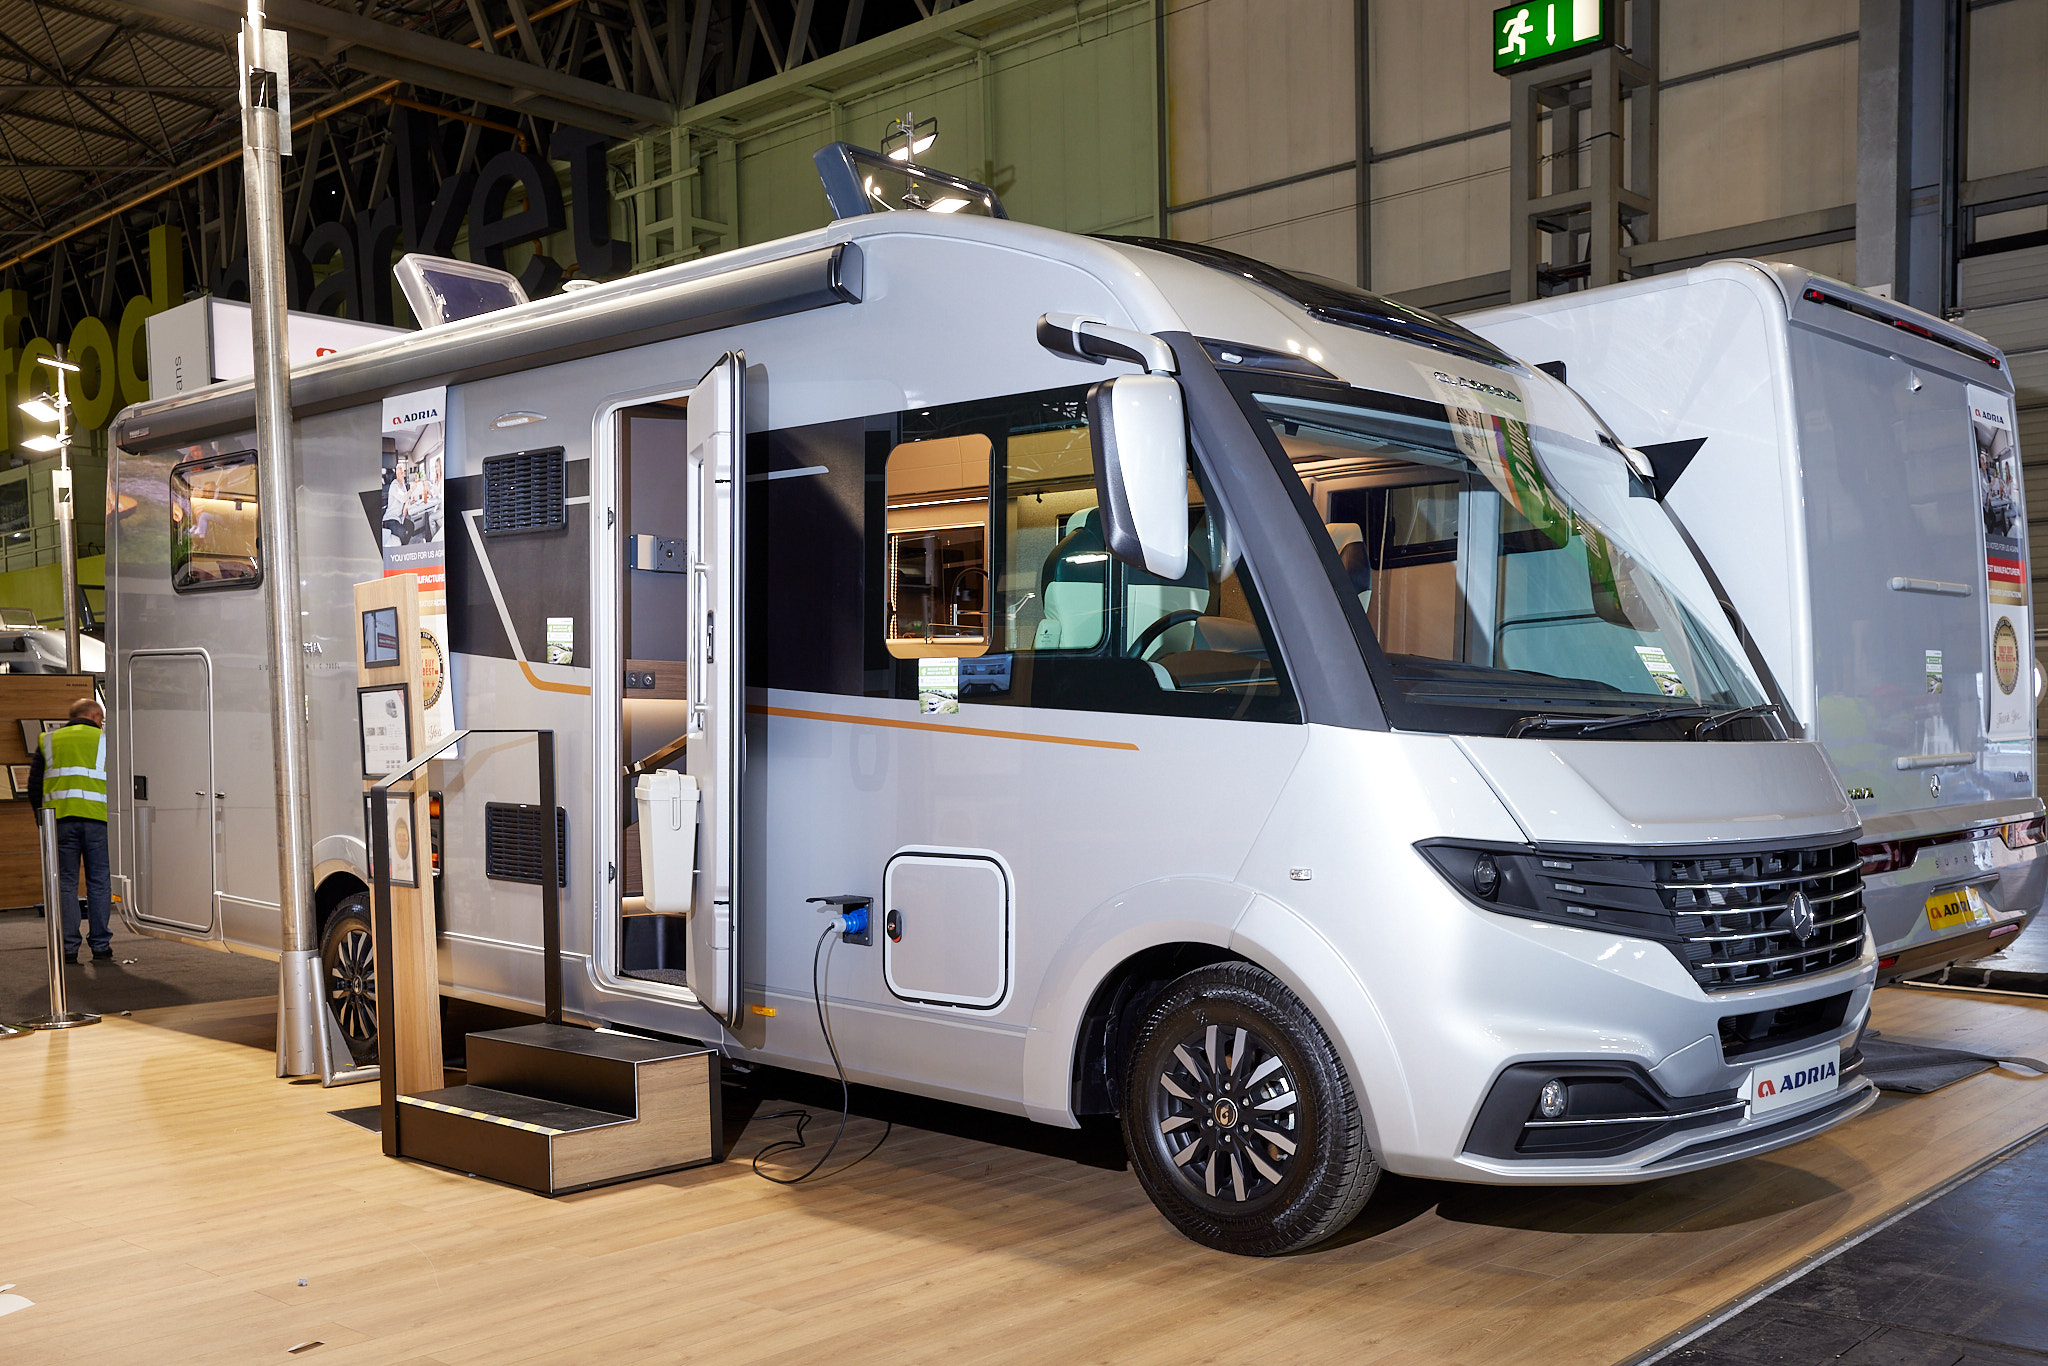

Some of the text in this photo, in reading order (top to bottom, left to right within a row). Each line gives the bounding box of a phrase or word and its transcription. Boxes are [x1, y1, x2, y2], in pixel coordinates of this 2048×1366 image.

[403, 408, 438, 424] ADRIA
[1982, 411, 2005, 425] ADRIA
[390, 554, 403, 562] YOU
[427, 550, 435, 559] US
[424, 658, 435, 667] BUY
[422, 667, 435, 676] BEST
[1943, 900, 1972, 918] ADRI
[1779, 1061, 1837, 1093] ADRIA
